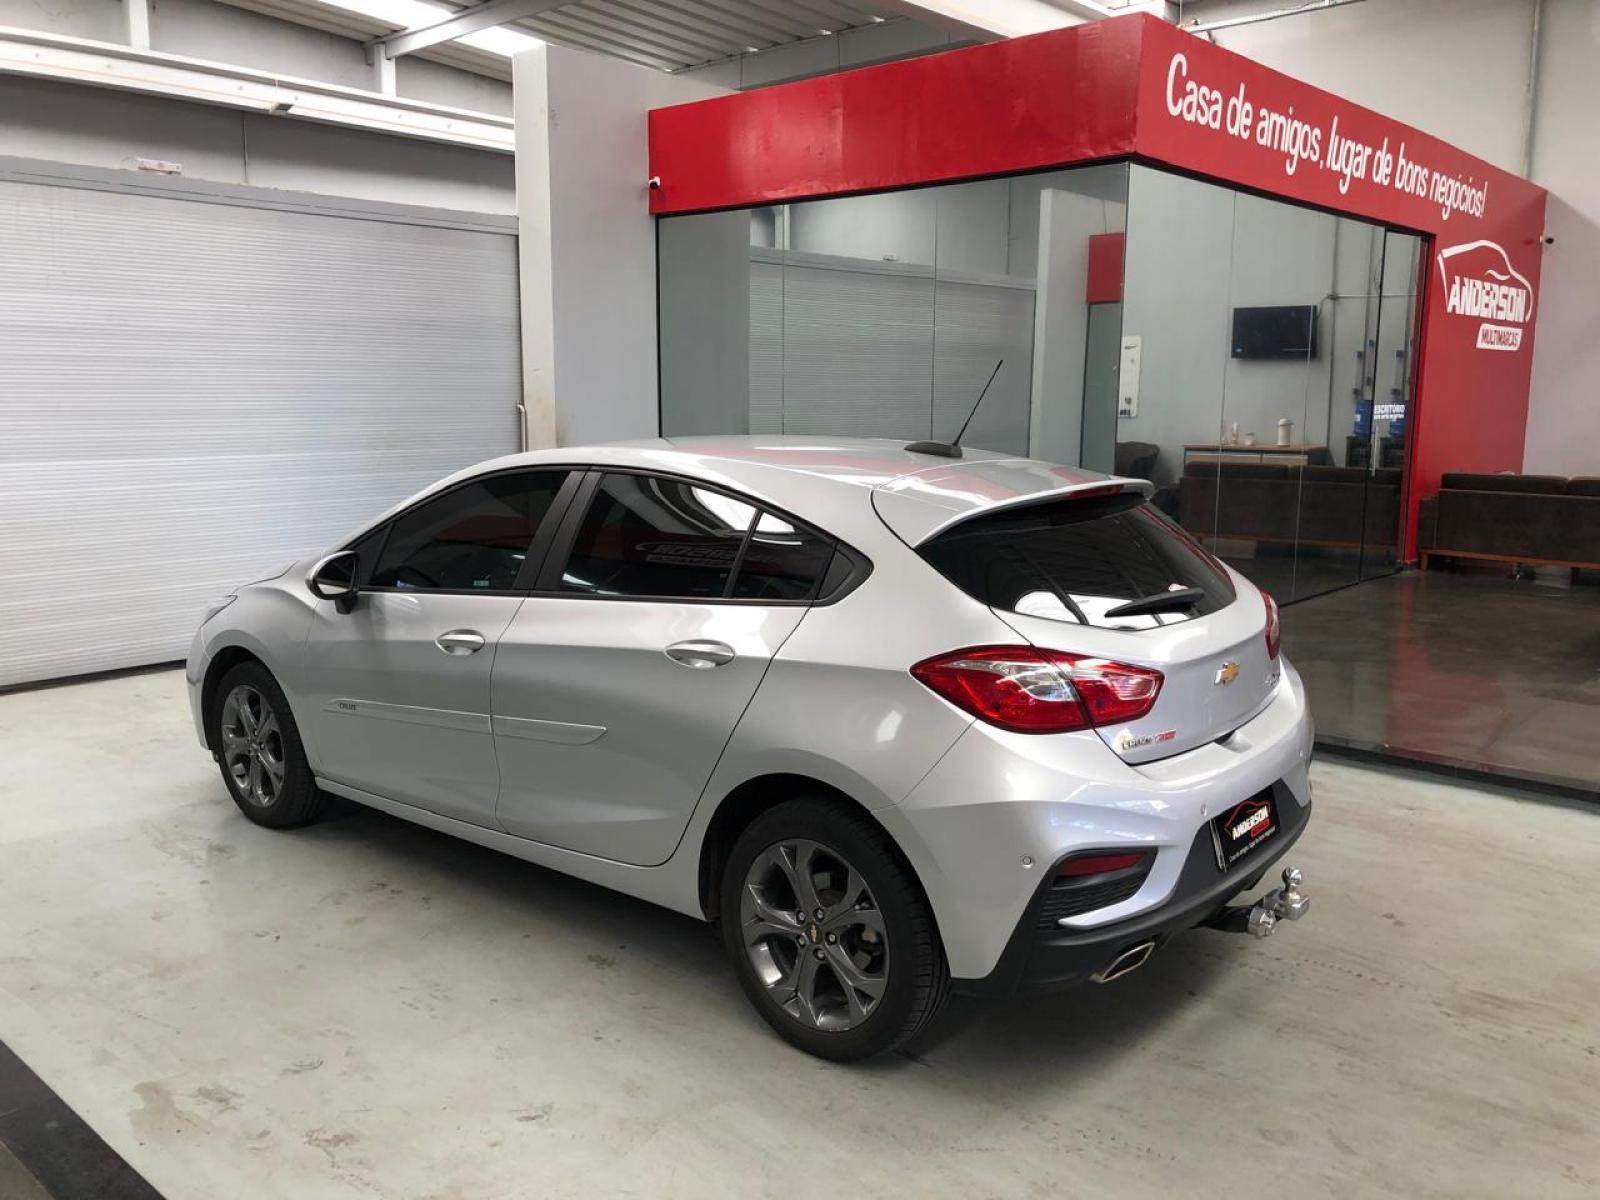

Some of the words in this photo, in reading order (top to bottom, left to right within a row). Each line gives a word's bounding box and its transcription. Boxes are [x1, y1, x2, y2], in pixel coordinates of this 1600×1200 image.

[1166, 53, 1223, 130] Casa
[1226, 82, 1253, 140] de
[1256, 106, 1324, 176] amigos,
[1325, 115, 1372, 195] lugar
[1372, 136, 1393, 186] de
[1394, 142, 1429, 198] bons
[1429, 174, 1488, 221] negócios!
[1447, 275, 1527, 323] ANDERSON
